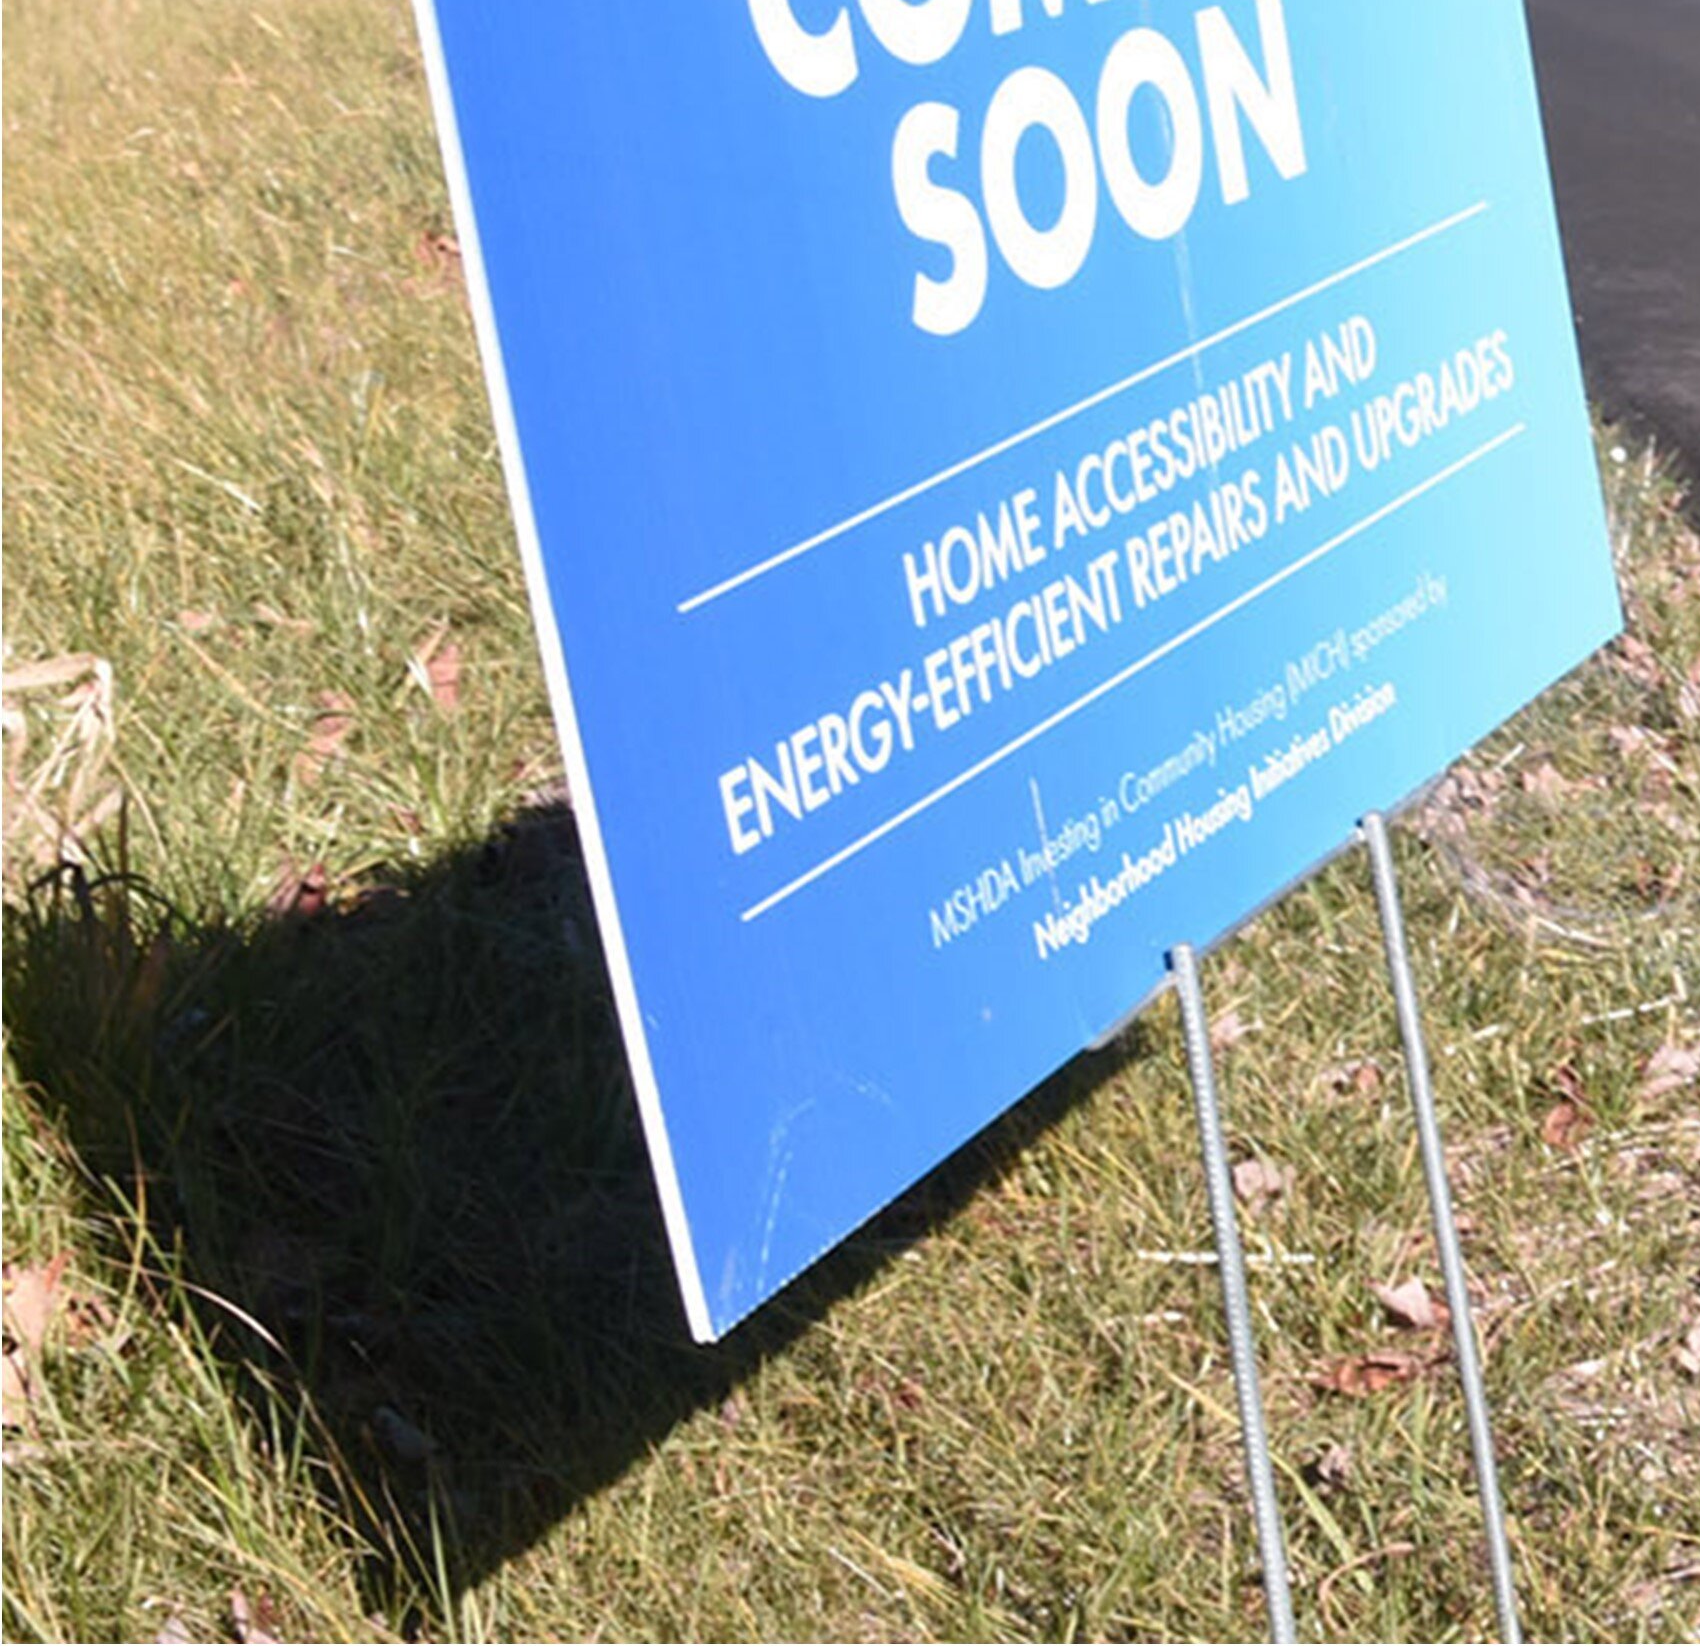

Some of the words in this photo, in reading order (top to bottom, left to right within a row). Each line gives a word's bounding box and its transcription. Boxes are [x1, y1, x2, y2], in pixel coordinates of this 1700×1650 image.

[718, 550, 1121, 855] ENERGY-EFFICIENT
[1126, 469, 1268, 609] REPAIRS
[1274, 425, 1350, 523] AND
[1352, 329, 1514, 471] UPGRADES
[903, 488, 1046, 627] HOME
[1053, 353, 1293, 549] ACCESSIBILITY
[1304, 315, 1378, 408] AND
[929, 859, 1021, 949] MSHDA
[1018, 812, 1101, 886] Investing
[1098, 795, 1121, 828] in
[1119, 729, 1217, 813] Community
[1214, 683, 1288, 746] Housing
[1032, 821, 1178, 961] Neighborhood
[1174, 782, 1253, 855] Housing
[1248, 732, 1332, 801] Initiatives
[1327, 680, 1398, 744] Division
